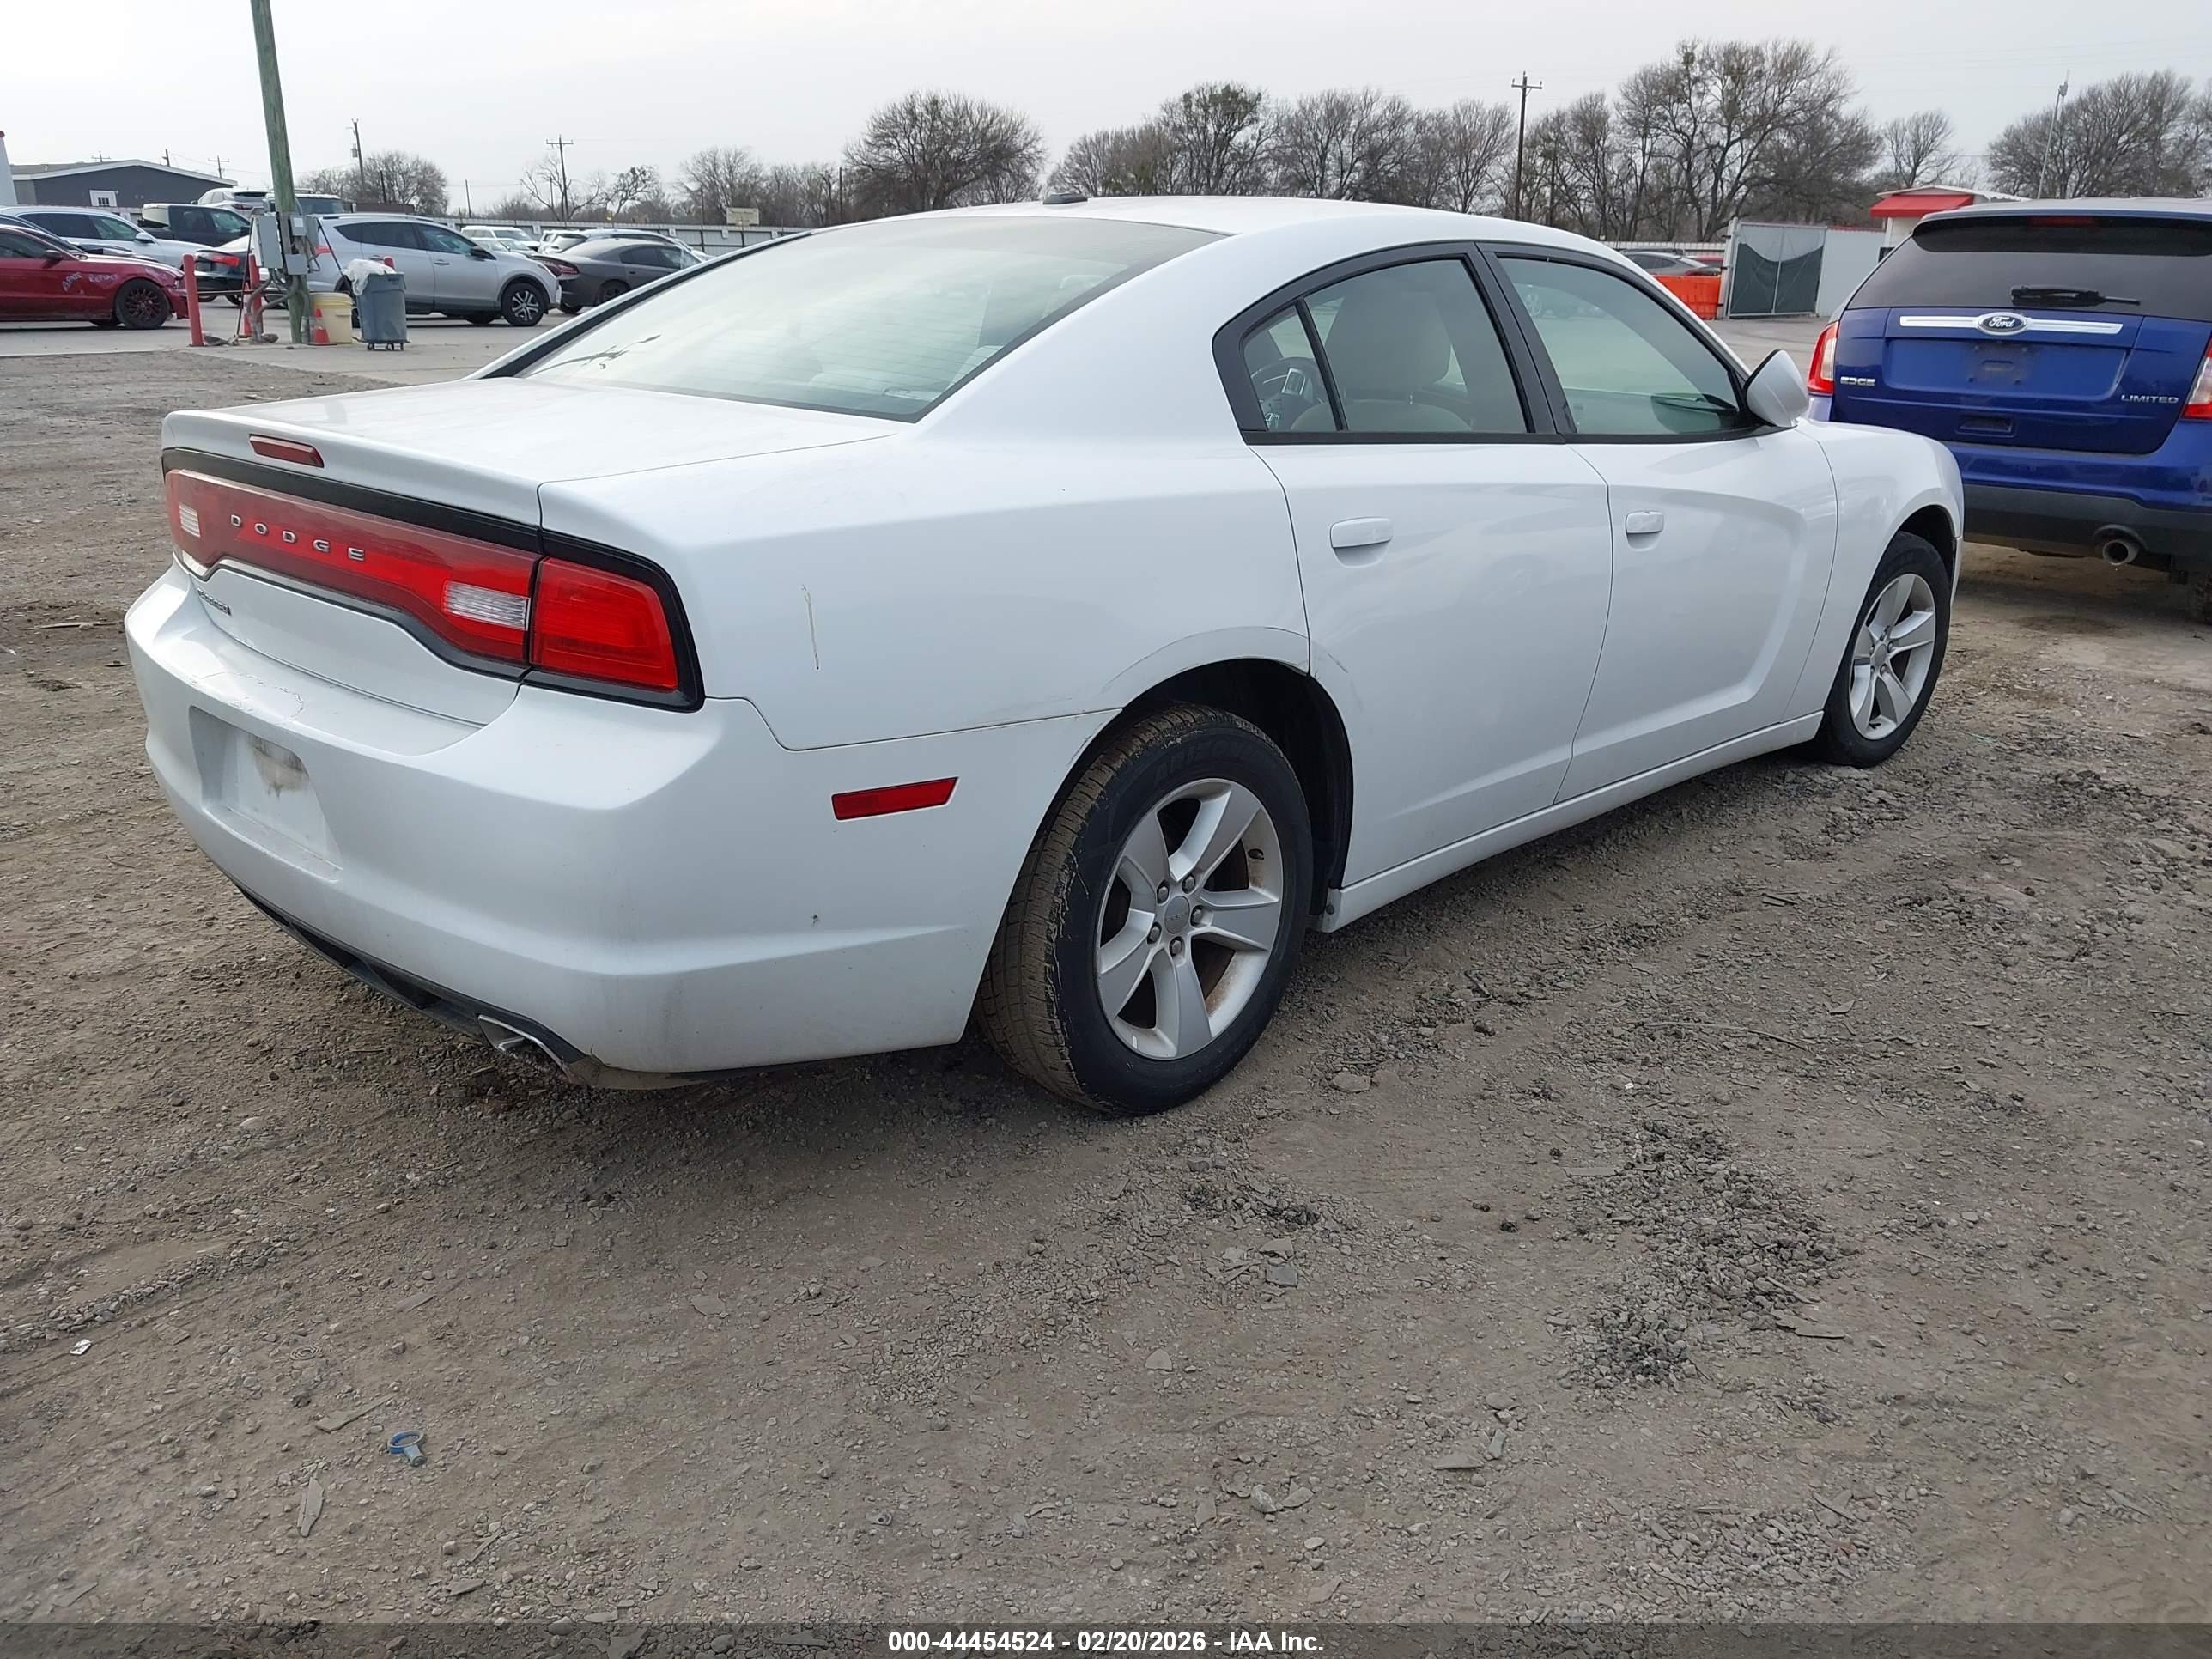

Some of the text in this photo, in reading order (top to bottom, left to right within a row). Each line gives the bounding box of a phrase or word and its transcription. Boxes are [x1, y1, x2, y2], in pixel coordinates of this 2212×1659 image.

[1989, 316, 2015, 328] Ford
[1840, 376, 1875, 386] EDGE
[2121, 394, 2179, 404] LIMITED
[230, 514, 365, 562] DODGE
